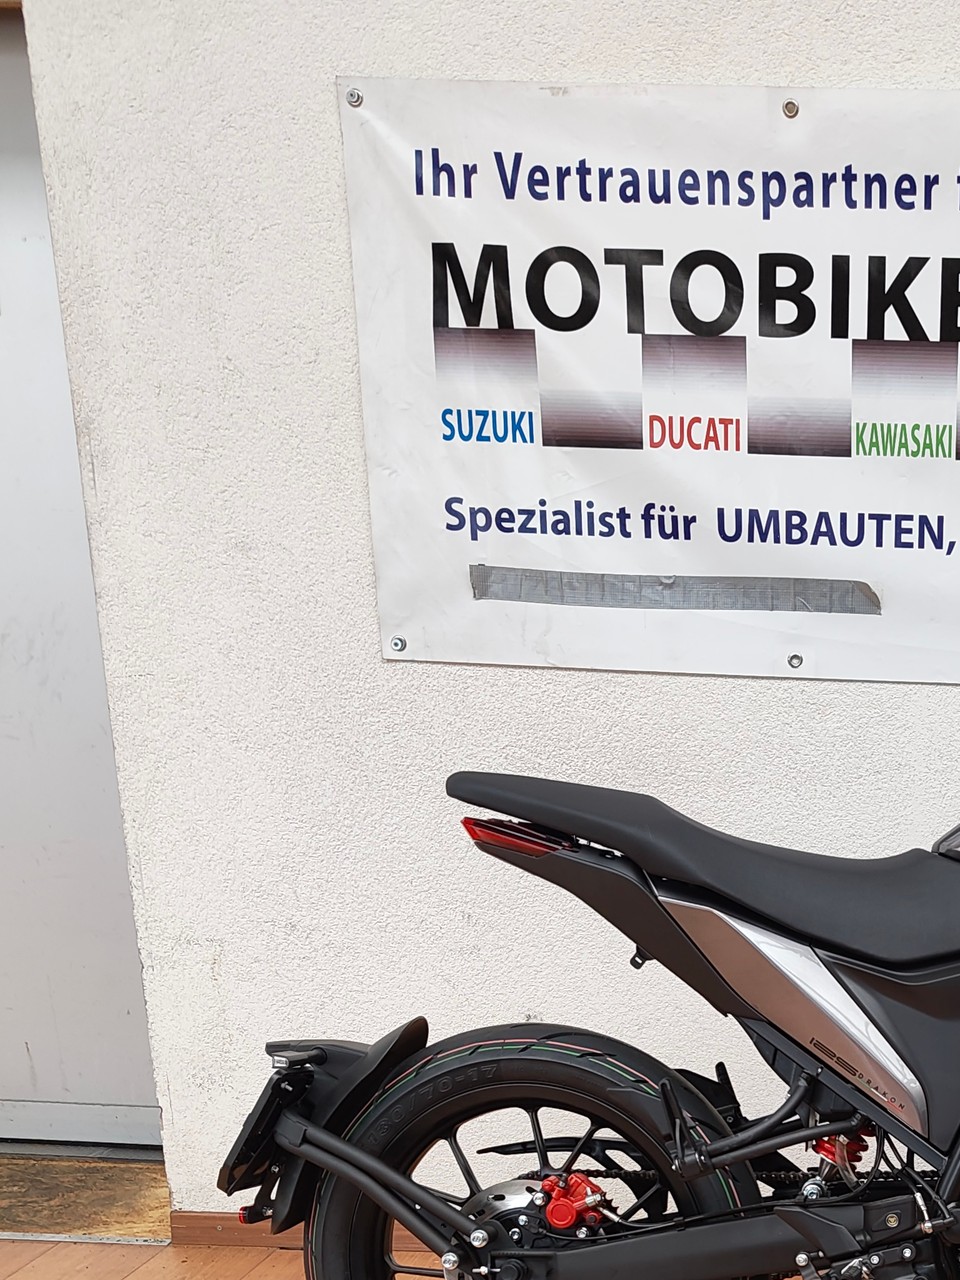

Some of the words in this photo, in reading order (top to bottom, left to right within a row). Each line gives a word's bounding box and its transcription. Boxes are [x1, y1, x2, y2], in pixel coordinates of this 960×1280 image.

[415, 148, 478, 198] Ihr
[494, 151, 940, 220] Vertrauenspartner
[441, 408, 535, 444] SUZUKI
[649, 415, 741, 452] DUCATI
[854, 422, 953, 459] KAWASAKI
[445, 497, 632, 541] Spezialist
[641, 502, 697, 541] für
[717, 508, 956, 556] UMBAUTEN,
[857, 1072, 906, 1111] DRAKON
